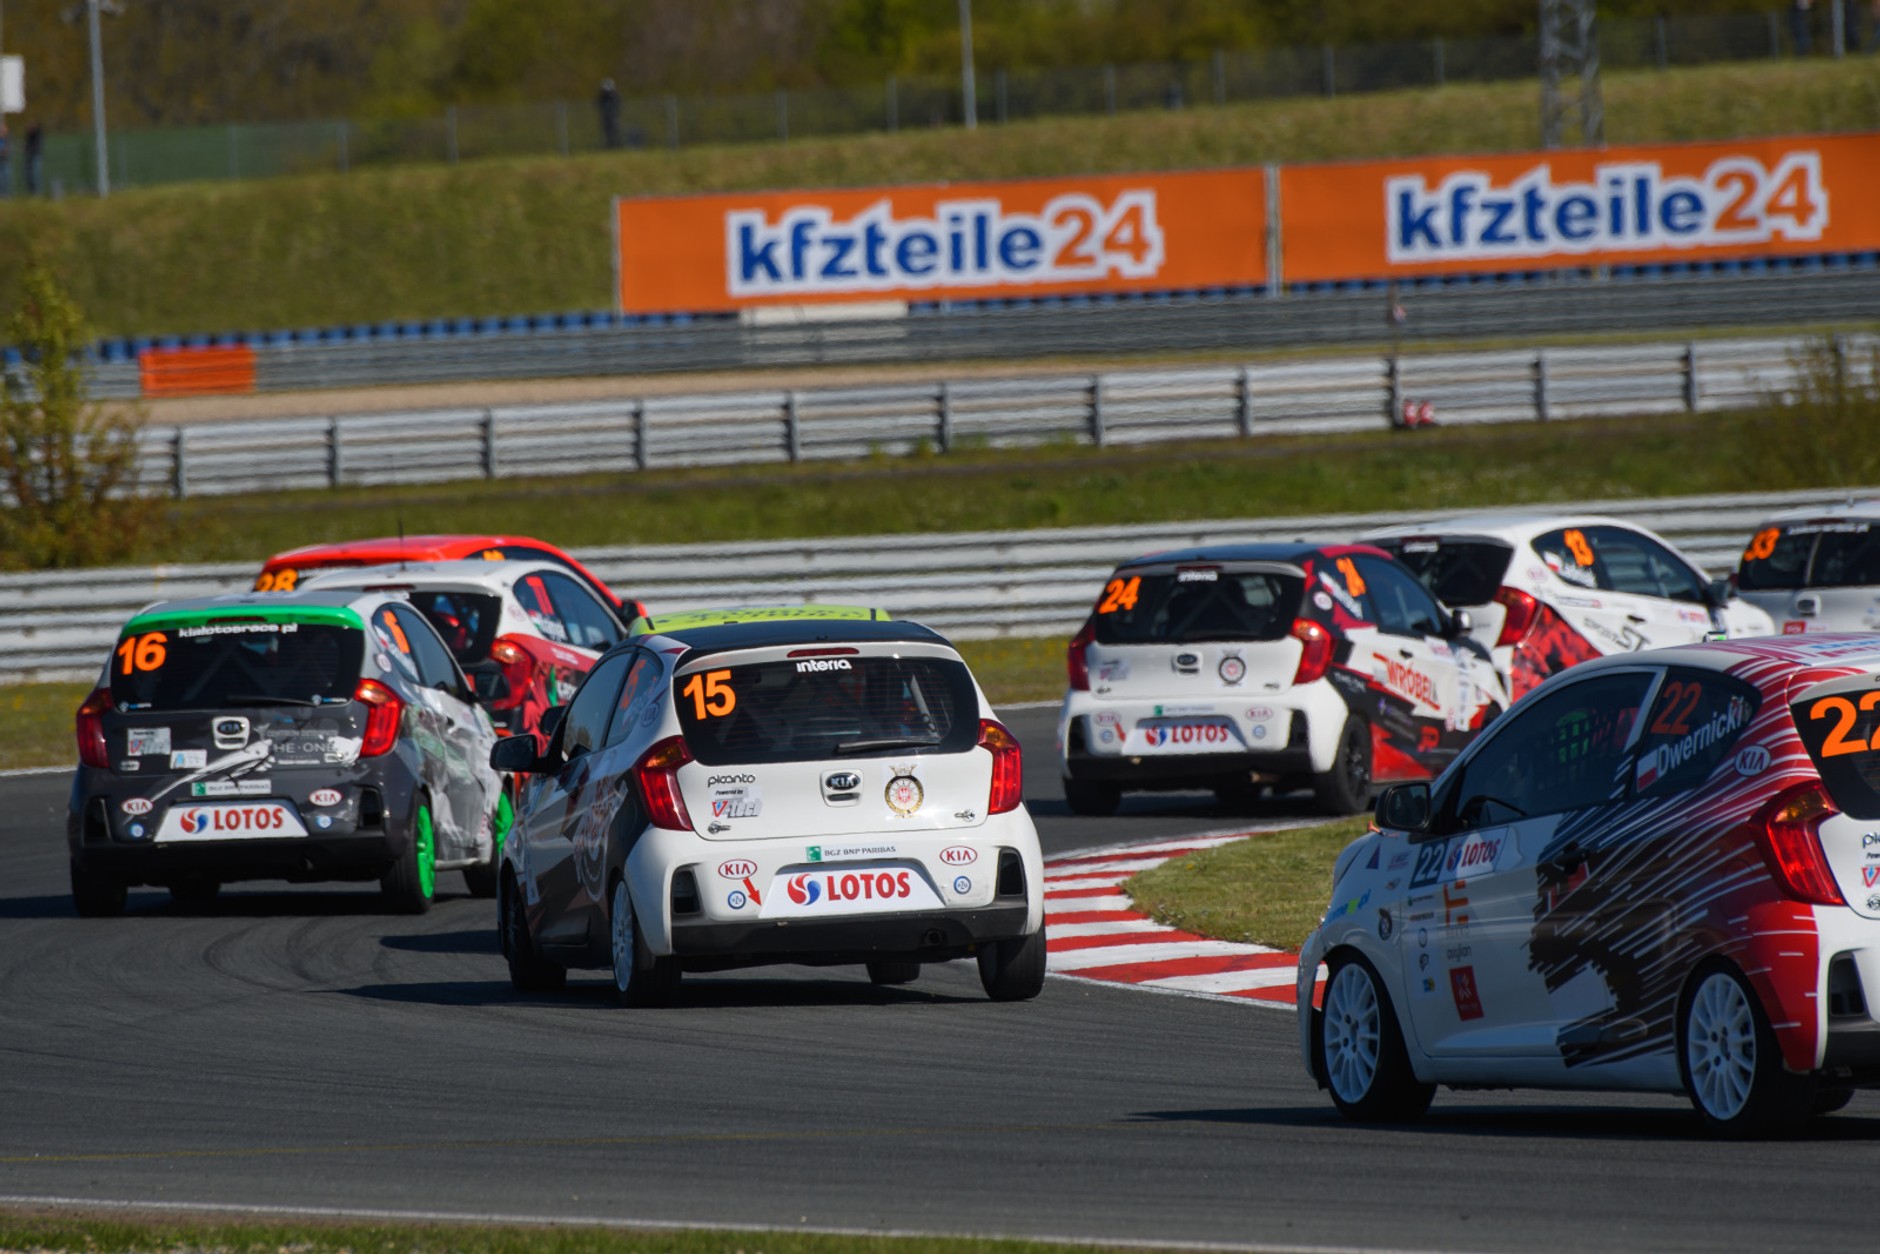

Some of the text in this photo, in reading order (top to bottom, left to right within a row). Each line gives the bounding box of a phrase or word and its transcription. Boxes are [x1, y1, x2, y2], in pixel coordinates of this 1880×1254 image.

[1397, 162, 1816, 250] kfzteile24
[736, 202, 1152, 285] kfzteile24
[1099, 575, 1141, 614] 24
[118, 631, 167, 675] 16
[796, 659, 852, 672] interia
[683, 670, 736, 720] 15
[1651, 681, 1703, 735] 22
[1171, 725, 1228, 743] LOTOS
[1656, 696, 1745, 780] Dwernicki
[708, 774, 756, 788] picanto
[831, 777, 855, 788] KIA
[214, 808, 284, 831] LOTOS
[843, 848, 861, 856] BNP
[861, 846, 897, 854] PARIBAS
[1414, 845, 1445, 881] 22
[1460, 839, 1501, 868] LOTOS
[826, 871, 912, 901] LOTOS
